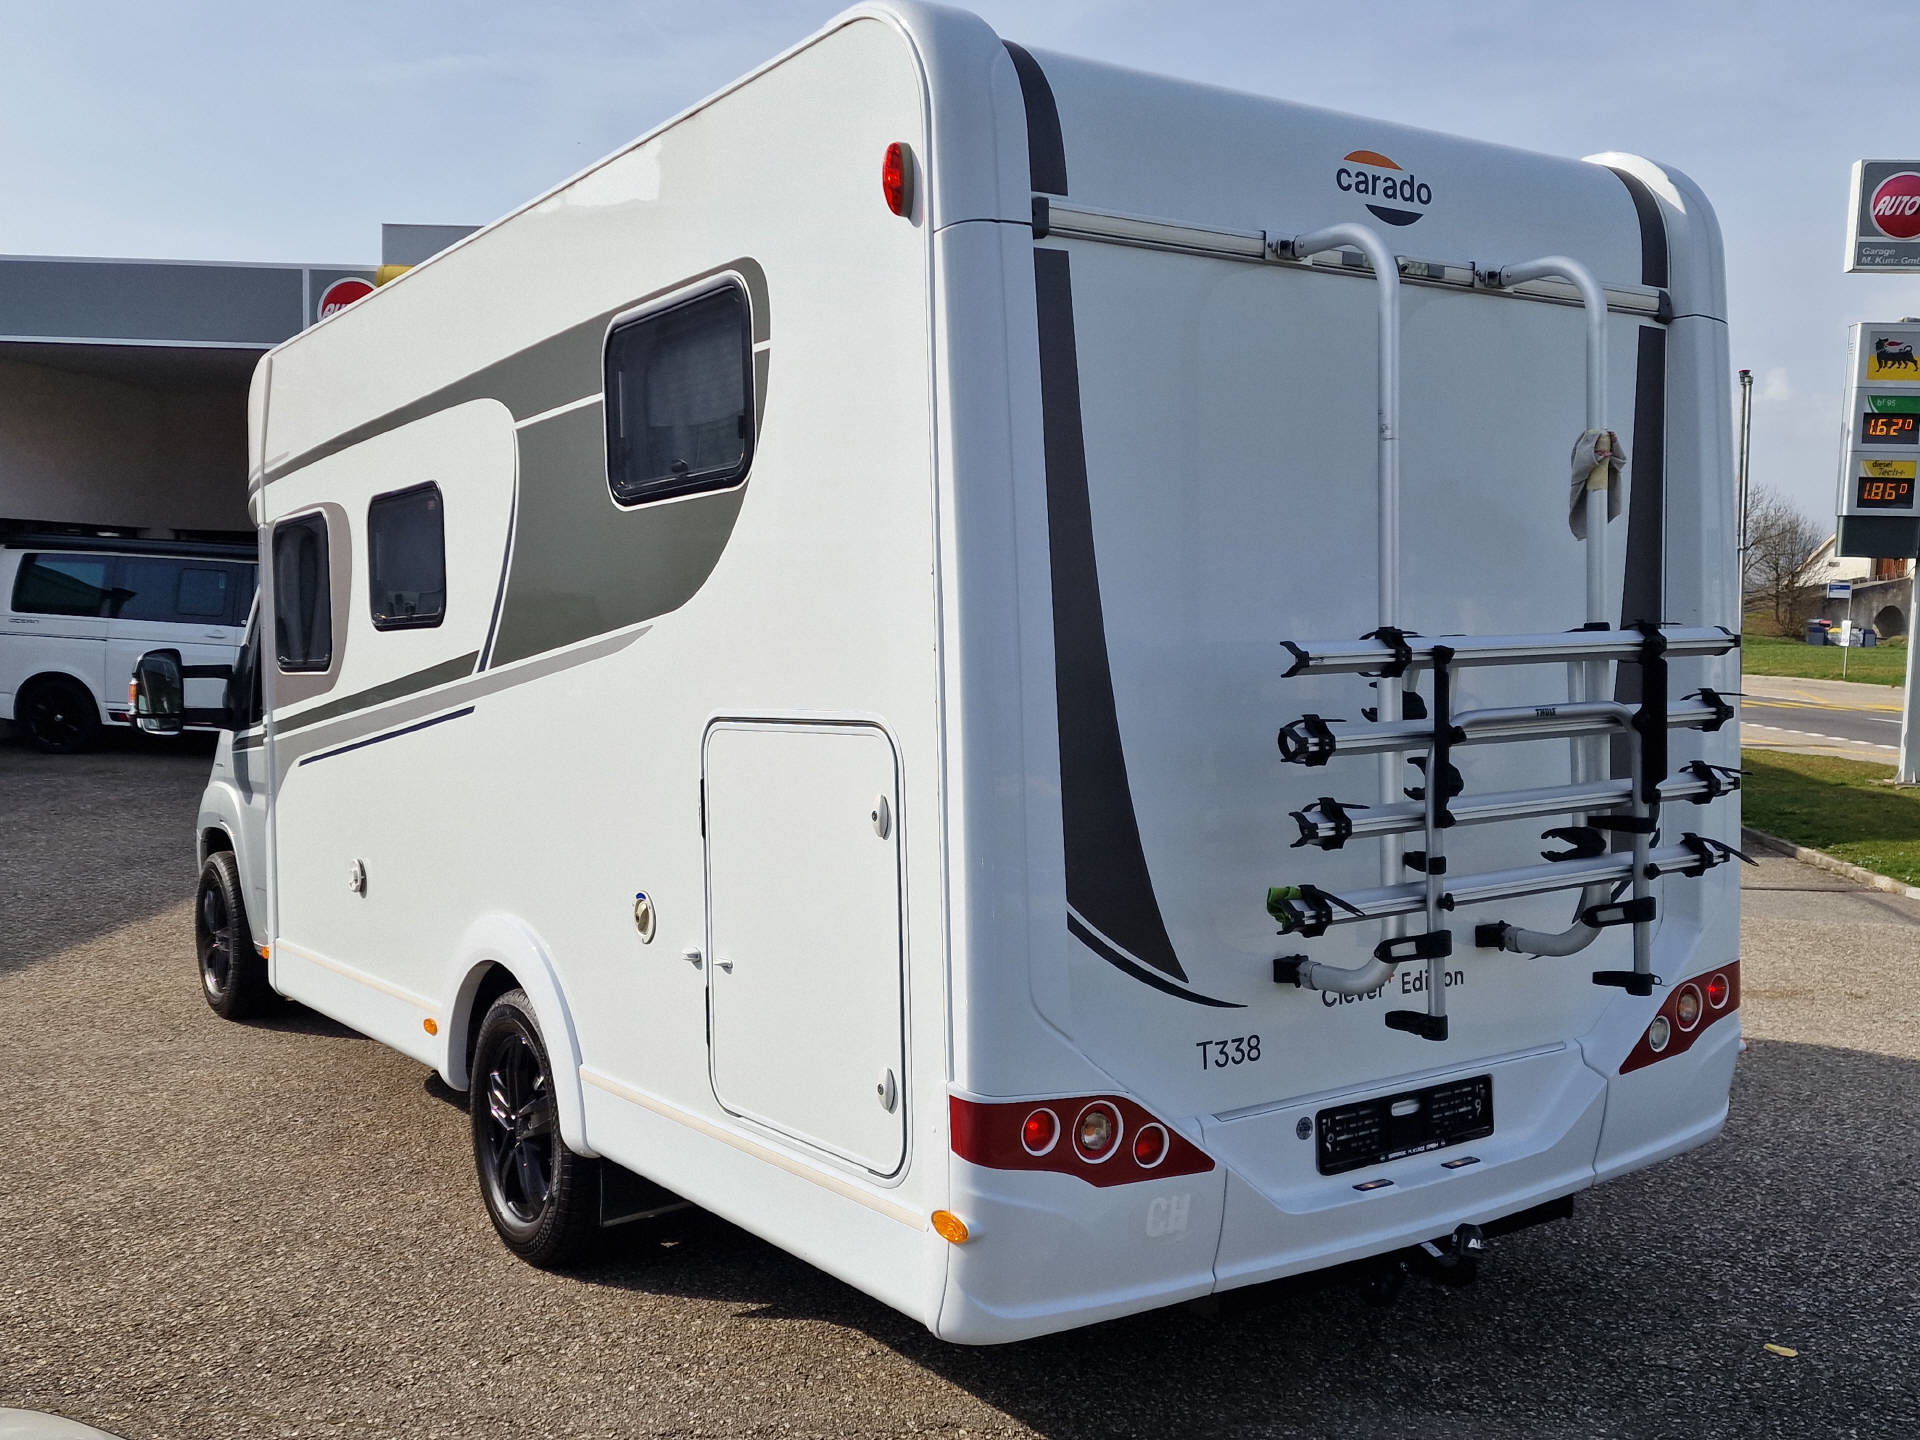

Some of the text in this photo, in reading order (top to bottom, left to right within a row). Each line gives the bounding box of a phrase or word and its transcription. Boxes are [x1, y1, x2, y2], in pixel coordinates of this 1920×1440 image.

[1336, 167, 1432, 206] carado
[1874, 195, 1920, 216] AUTO
[1862, 247, 1896, 257] Garage
[1401, 969, 1464, 994] Edion
[1195, 1034, 1261, 1070] T338
